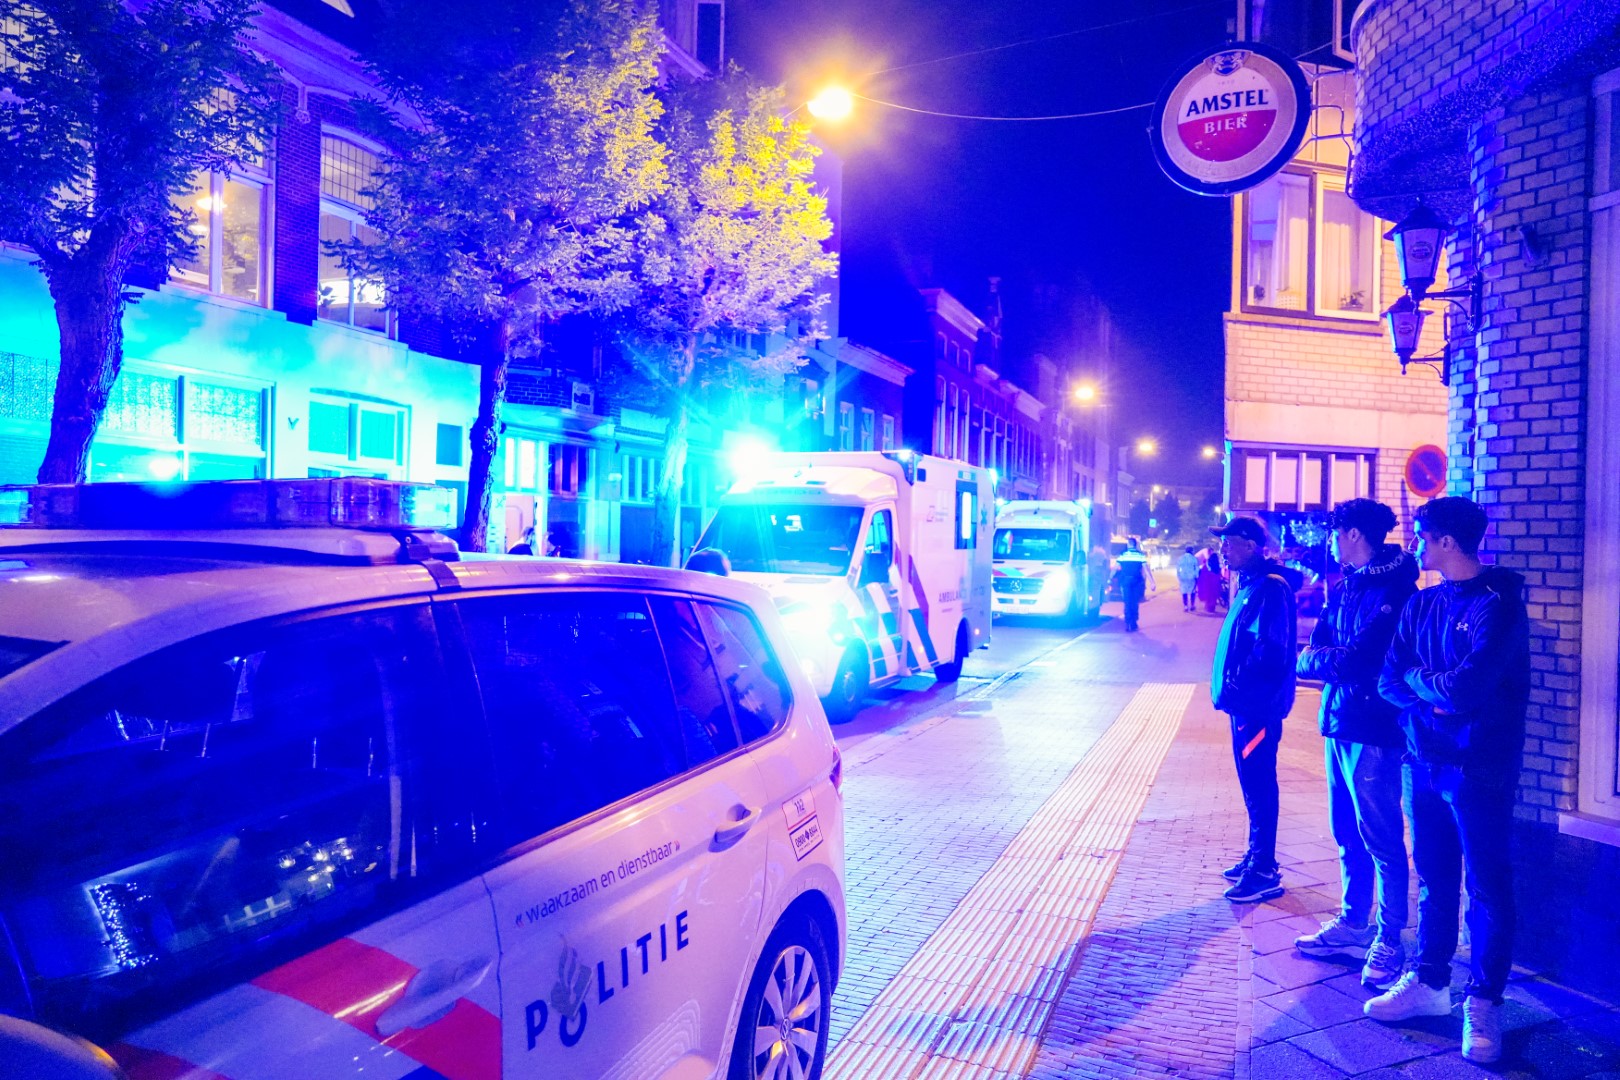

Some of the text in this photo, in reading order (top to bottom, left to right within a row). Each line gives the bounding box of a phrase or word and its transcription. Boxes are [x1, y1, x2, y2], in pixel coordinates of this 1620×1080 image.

[1186, 89, 1269, 117] AMSTEL
[1204, 117, 1248, 134] BIER
[526, 878, 599, 924] waakzaam
[600, 870, 616, 888] en
[617, 842, 672, 880] dienstbaar
[525, 909, 689, 1051] POLITIE
